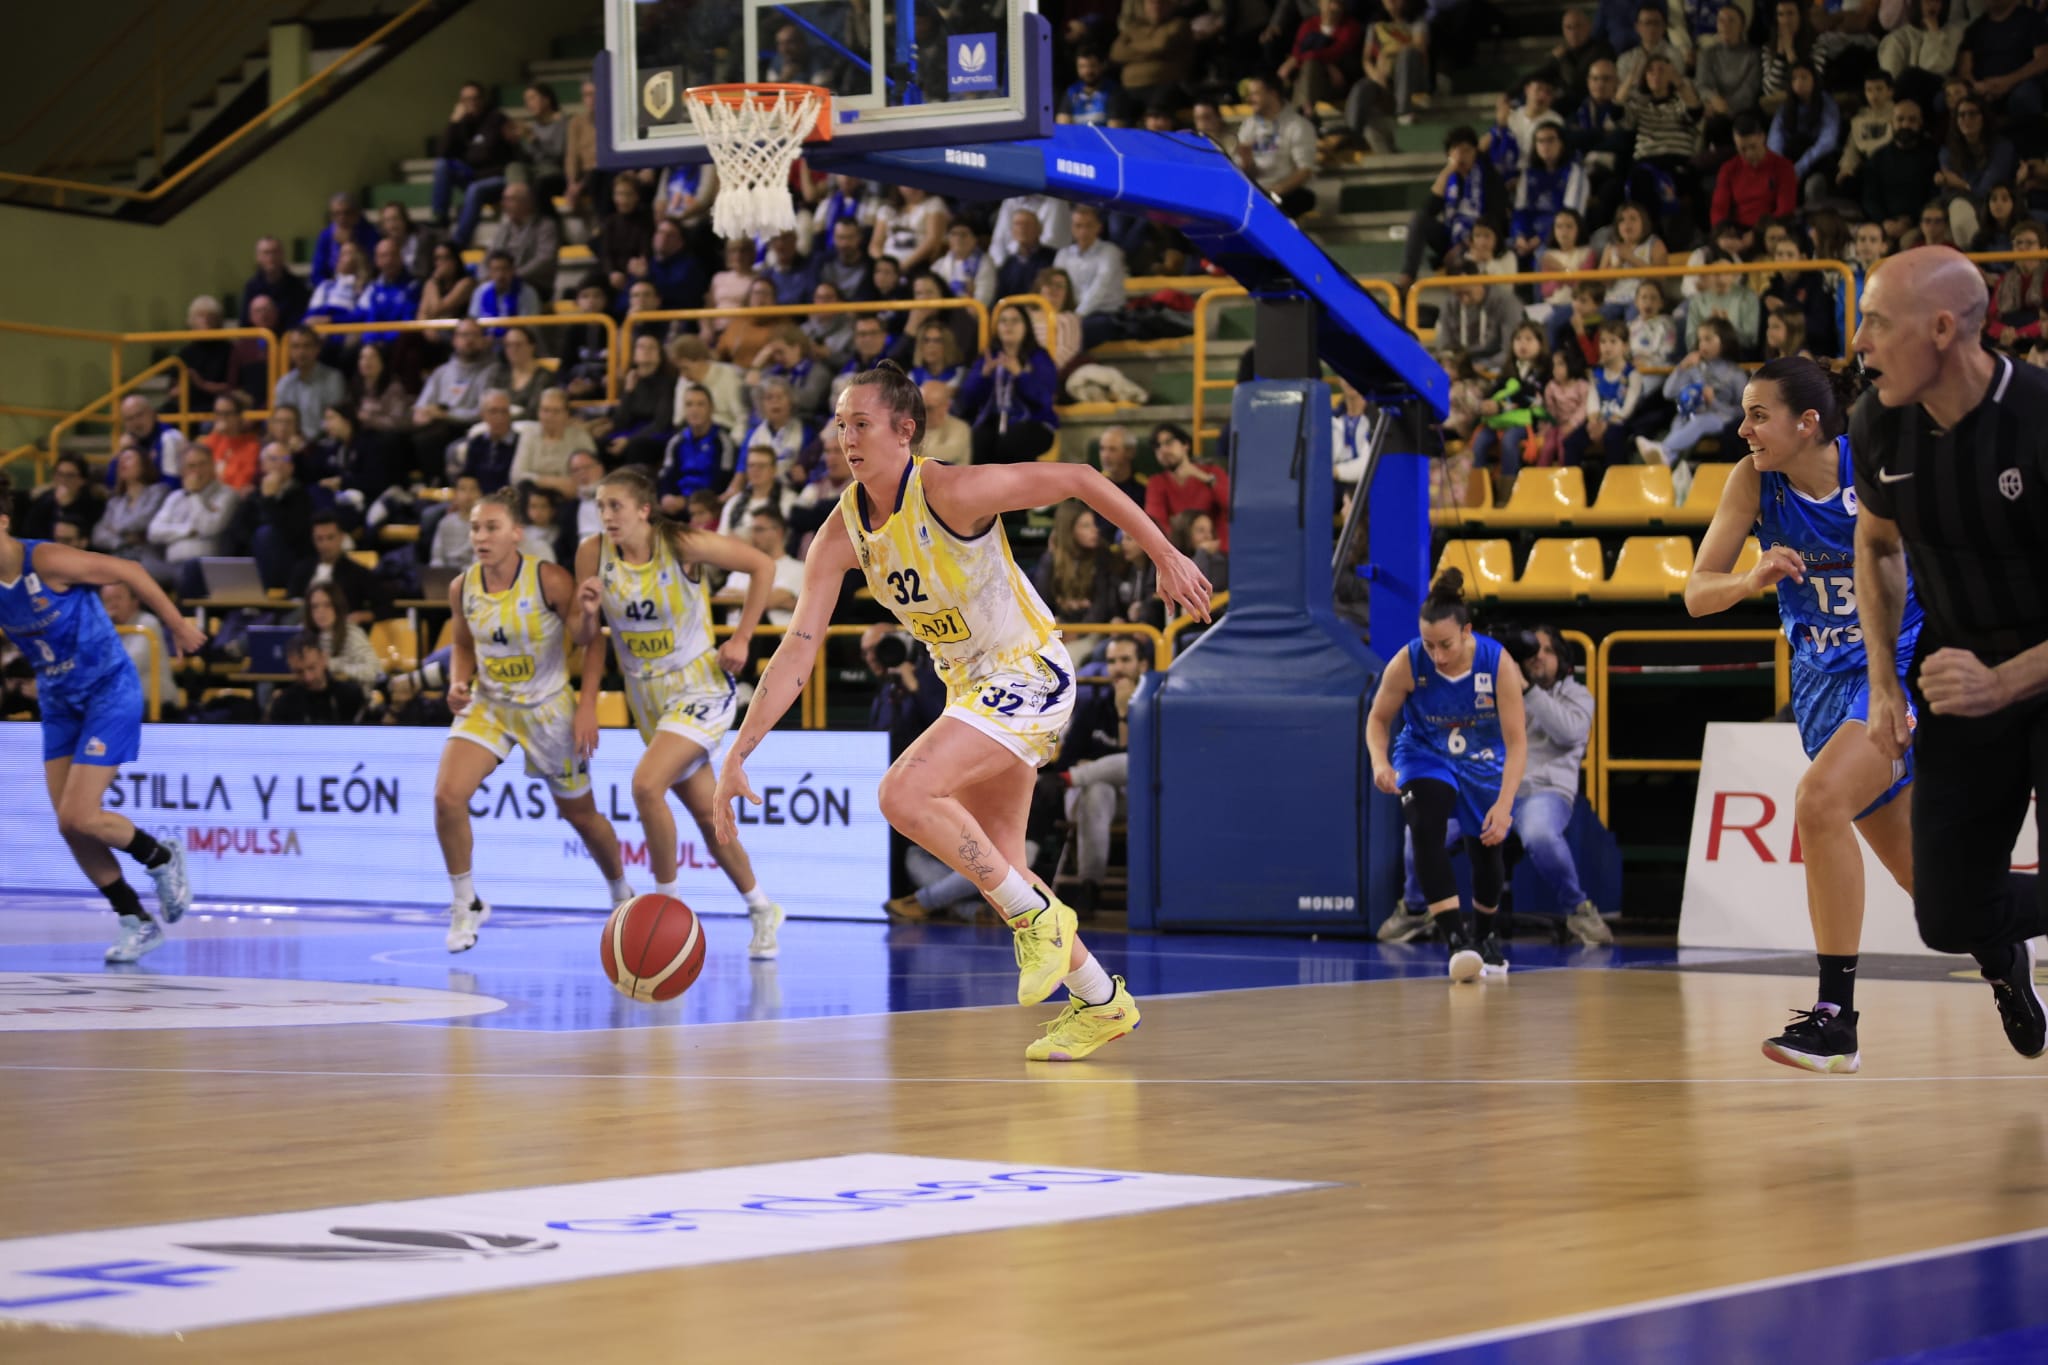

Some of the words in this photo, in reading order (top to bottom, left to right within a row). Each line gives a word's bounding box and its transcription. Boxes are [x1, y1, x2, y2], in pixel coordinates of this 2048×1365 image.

[945, 148, 987, 168] MONDO
[1057, 157, 1096, 179] MONDO
[887, 568, 928, 605] 32
[1809, 577, 1857, 615] 13
[626, 599, 658, 621] 42
[492, 626, 508, 646] 4
[682, 703, 710, 721] 42
[982, 686, 1024, 717] 32
[1447, 727, 1467, 755] 6
[102, 773, 232, 810] STILLA
[253, 774, 278, 820] Y
[297, 762, 399, 813] LEÓN
[738, 773, 850, 826] LEÓN
[1298, 896, 1354, 911] MONDO
[546, 1171, 1141, 1234] endesa
